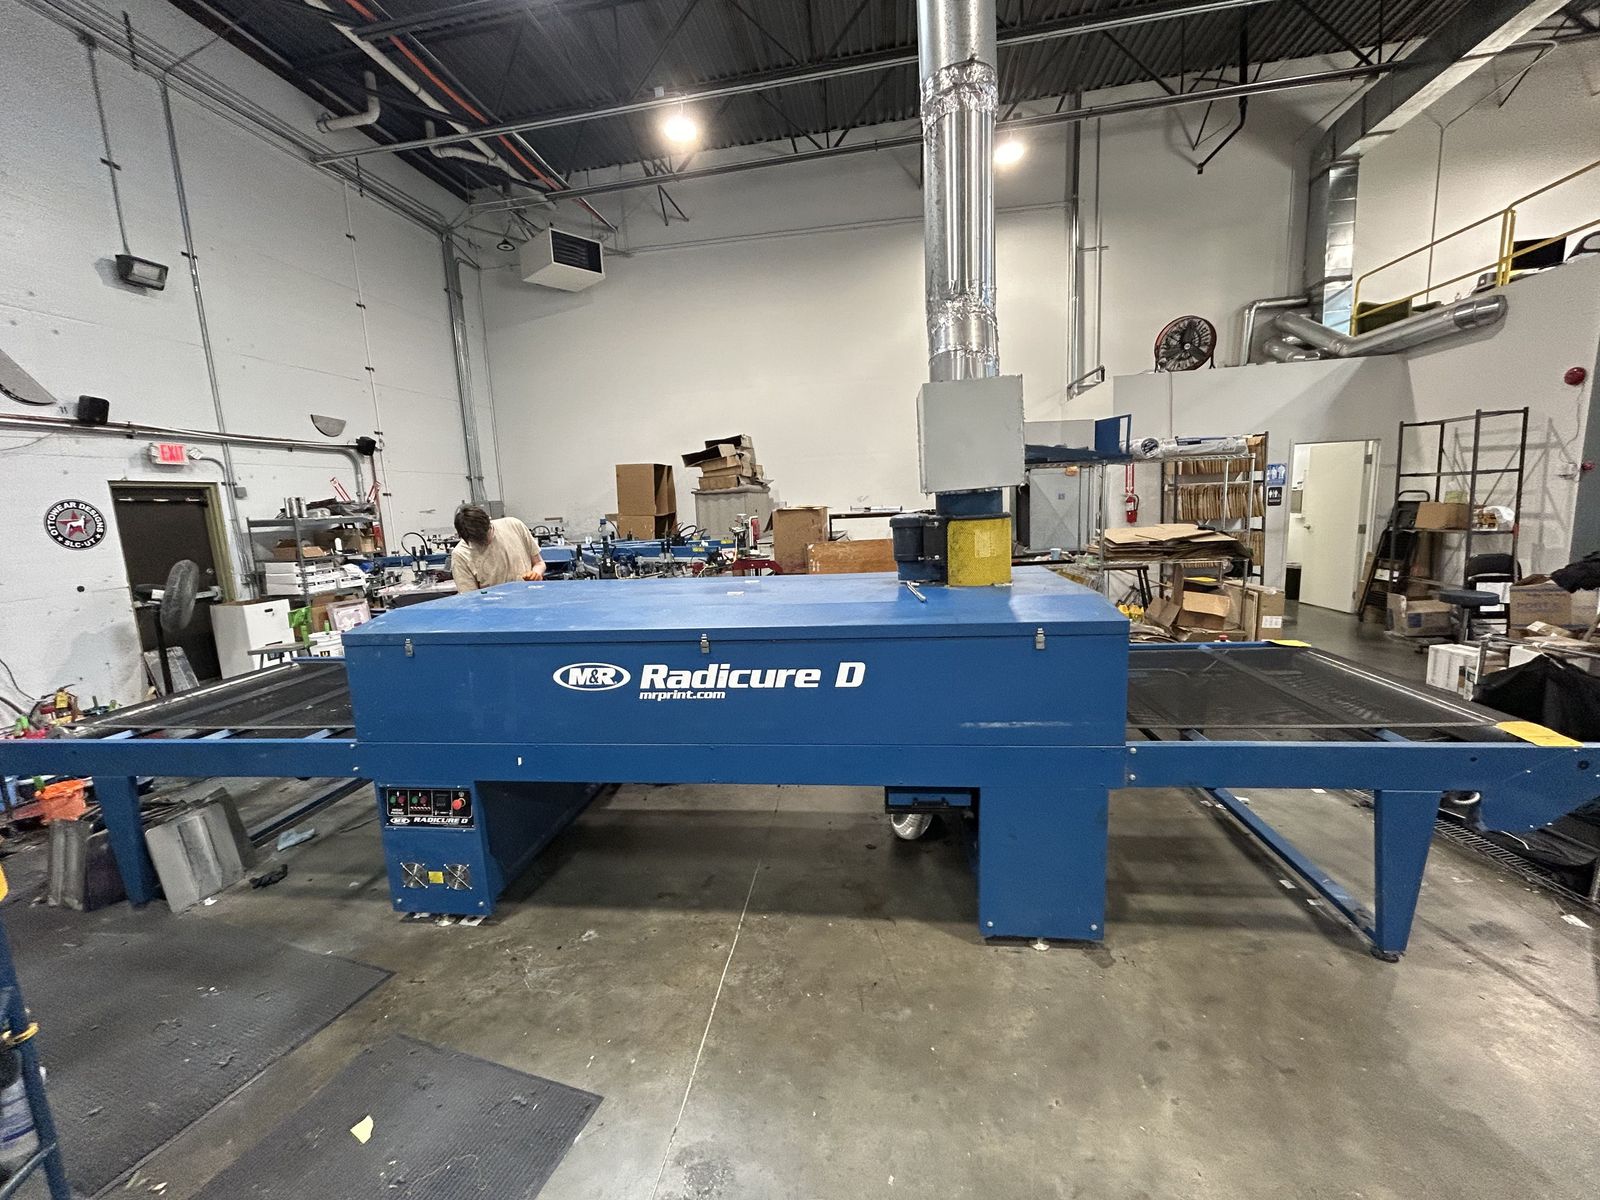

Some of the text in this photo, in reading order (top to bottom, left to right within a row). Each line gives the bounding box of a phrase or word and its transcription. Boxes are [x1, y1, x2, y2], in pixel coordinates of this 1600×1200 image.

[160, 444, 184, 462] EXIT
[47, 502, 105, 536] OTTOWEAR DESIGNS
[568, 667, 615, 685] M&R
[640, 662, 866, 689] Radicure D
[639, 690, 726, 701] mrprint.com
